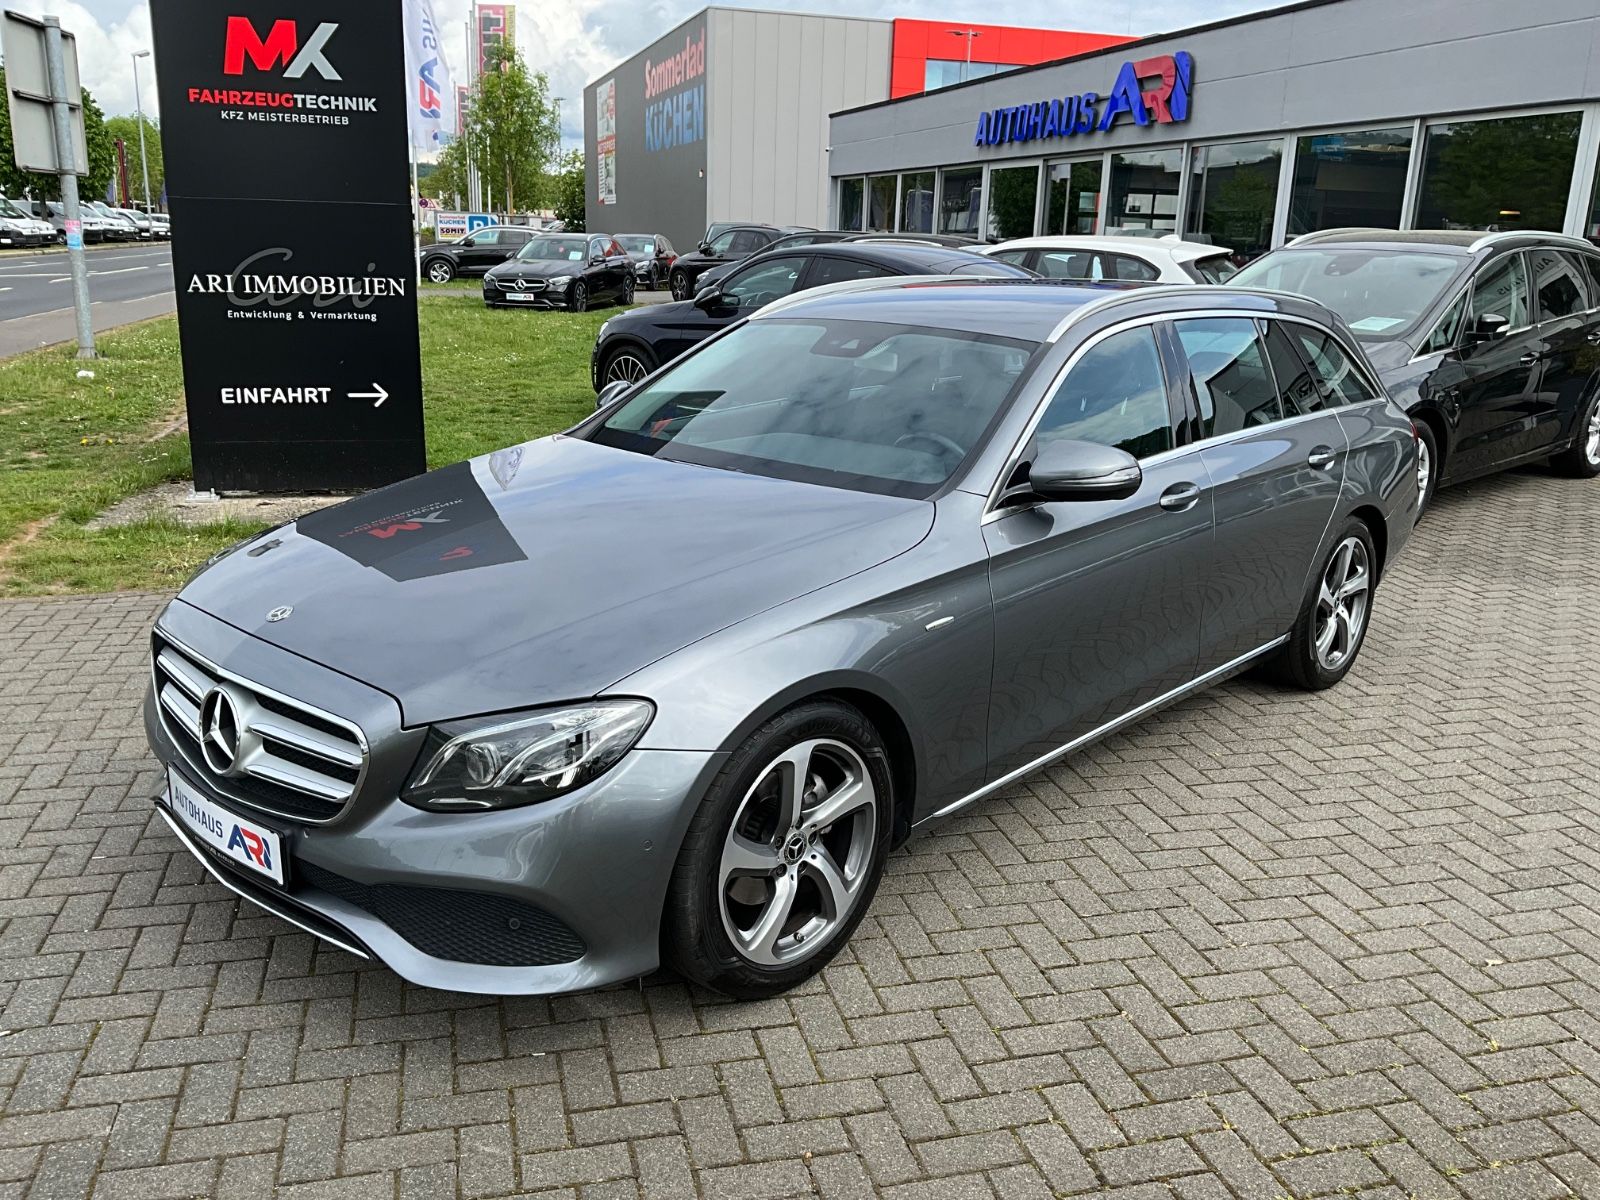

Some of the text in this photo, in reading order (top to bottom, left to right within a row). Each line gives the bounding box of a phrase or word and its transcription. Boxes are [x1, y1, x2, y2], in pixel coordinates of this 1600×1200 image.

[224, 16, 342, 81] MK
[645, 27, 705, 99] Sommerlad
[188, 88, 377, 112] FAHRZEUGTECHNIK
[221, 110, 349, 125] KFZ MEISTERBETRIEB
[645, 84, 705, 153] KÜCHEN
[975, 50, 1195, 146] AUTOHAUS ARI
[187, 274, 406, 297] ARI IMMOBILIEN
[227, 310, 378, 322] Entwicklung & Vermarktung
[220, 387, 332, 405] EINFAHRT
[174, 785, 224, 839] AUTOHAUS
[227, 823, 273, 871] ARI
